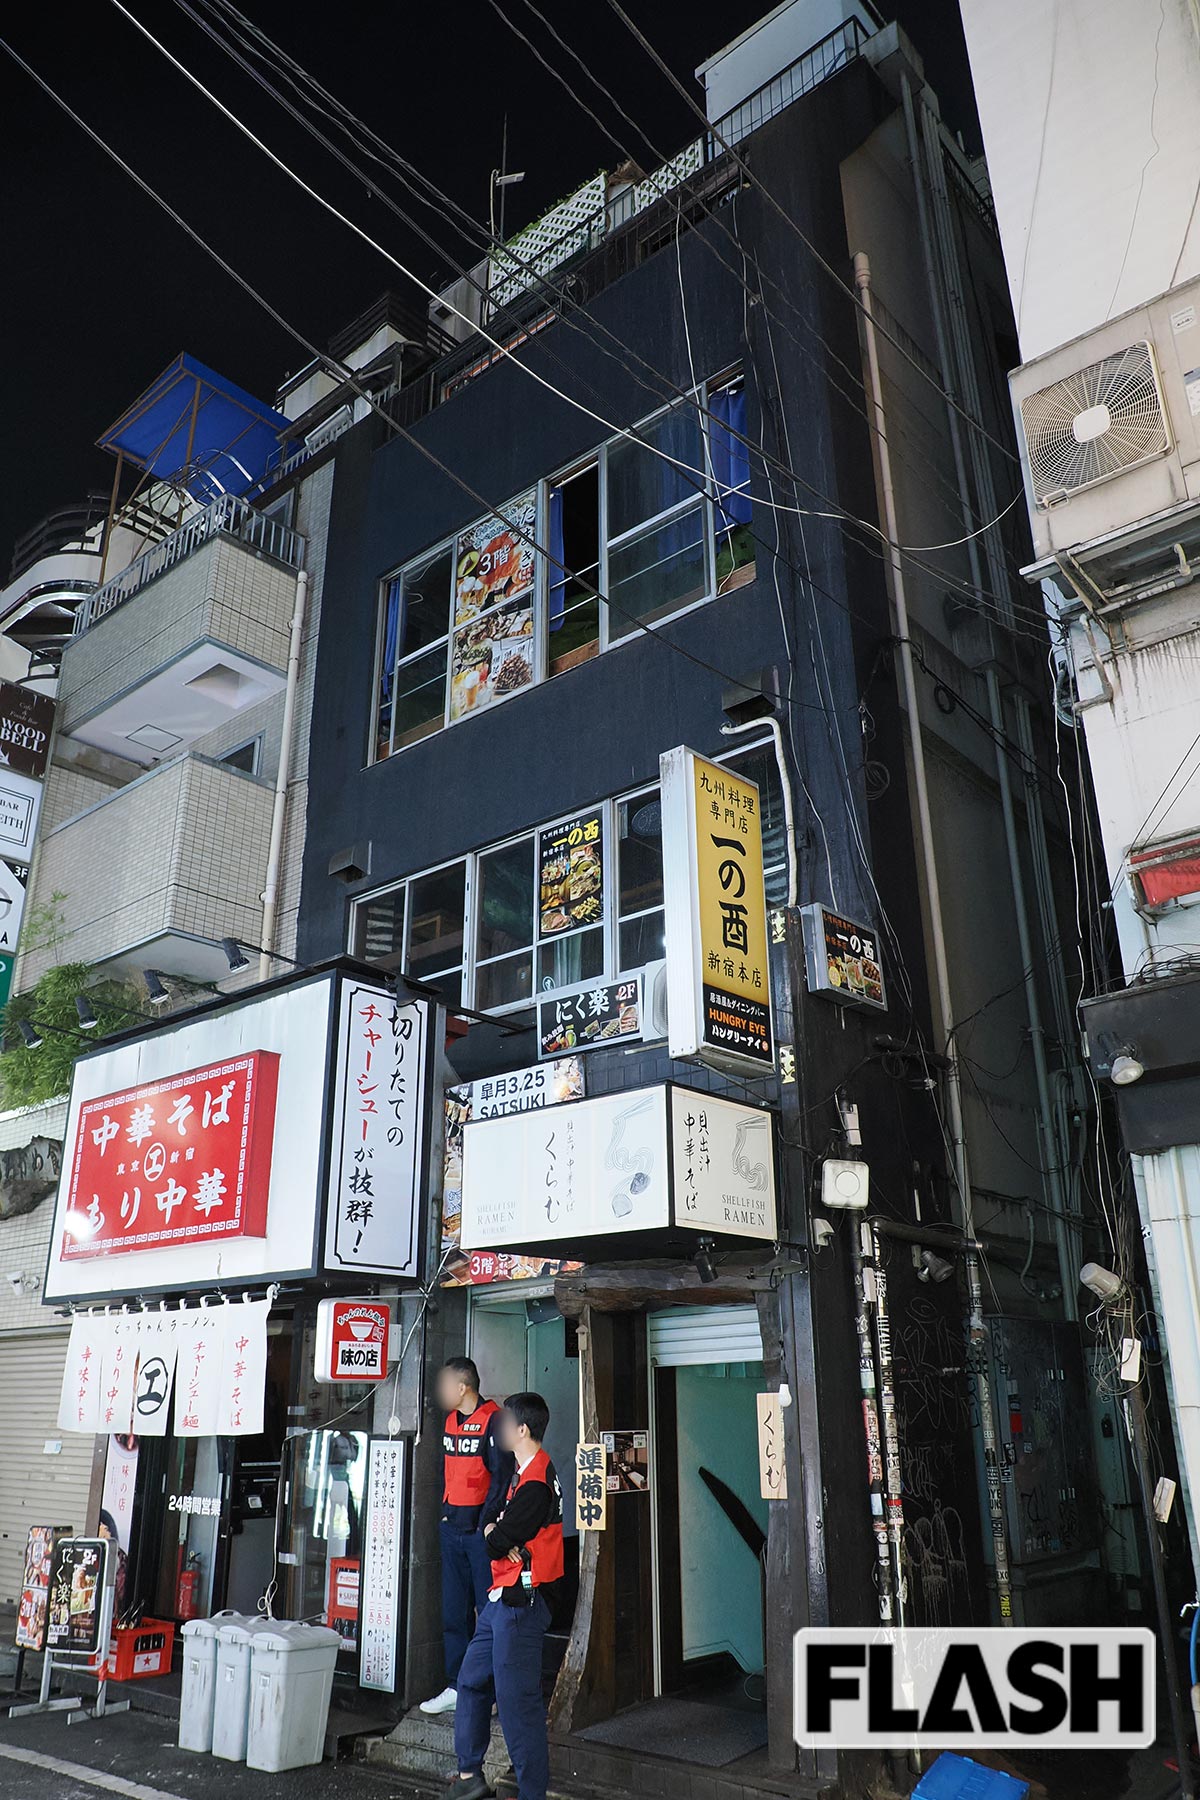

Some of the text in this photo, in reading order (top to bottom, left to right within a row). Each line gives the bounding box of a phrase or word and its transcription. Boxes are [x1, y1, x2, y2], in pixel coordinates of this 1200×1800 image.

[479, 545, 511, 576] 3階
[0, 727, 43, 754] BELL
[2, 717, 46, 742] WOOD
[1, 801, 19, 812] BAR
[700, 772, 755, 815] 九州料理
[710, 800, 748, 834] 専門店
[14, 865, 28, 879] 3F
[708, 833, 748, 956] 一の酉
[708, 951, 762, 988] 新宿本店
[556, 988, 610, 1023] にく楽
[619, 982, 636, 1000] 2F
[709, 1008, 767, 1036] HUNGRY EYE
[712, 1025, 761, 1049] ハングリーアイ
[387, 1006, 413, 1146] 切りたての
[481, 1070, 545, 1101] 皐月3.25
[92, 1080, 236, 1157] 中華そば
[480, 1092, 546, 1119] SATSUKI
[698, 1110, 711, 1174] 貝出汁
[116, 1160, 140, 1176] 東京
[169, 1147, 195, 1164] 新宿
[684, 1112, 698, 1211] 中華そば
[544, 1132, 560, 1224] くらむ
[86, 1168, 227, 1233] もり中華
[722, 1194, 766, 1210] SHELLFISH
[477, 1212, 514, 1226] RAMEN
[724, 1208, 765, 1226] RAMEN
[471, 1256, 494, 1276] 3階
[341, 1349, 378, 1366] 味の店
[105, 1346, 124, 1424] もり中華
[182, 1341, 206, 1429] チャーシュー麺
[231, 1336, 250, 1427] 中華そば
[764, 1411, 780, 1489] くらむ
[118, 1464, 129, 1511] 味の店
[578, 1447, 604, 1527] 準備中
[168, 1495, 221, 1516] 24時間営業
[82, 1551, 97, 1565] 2F
